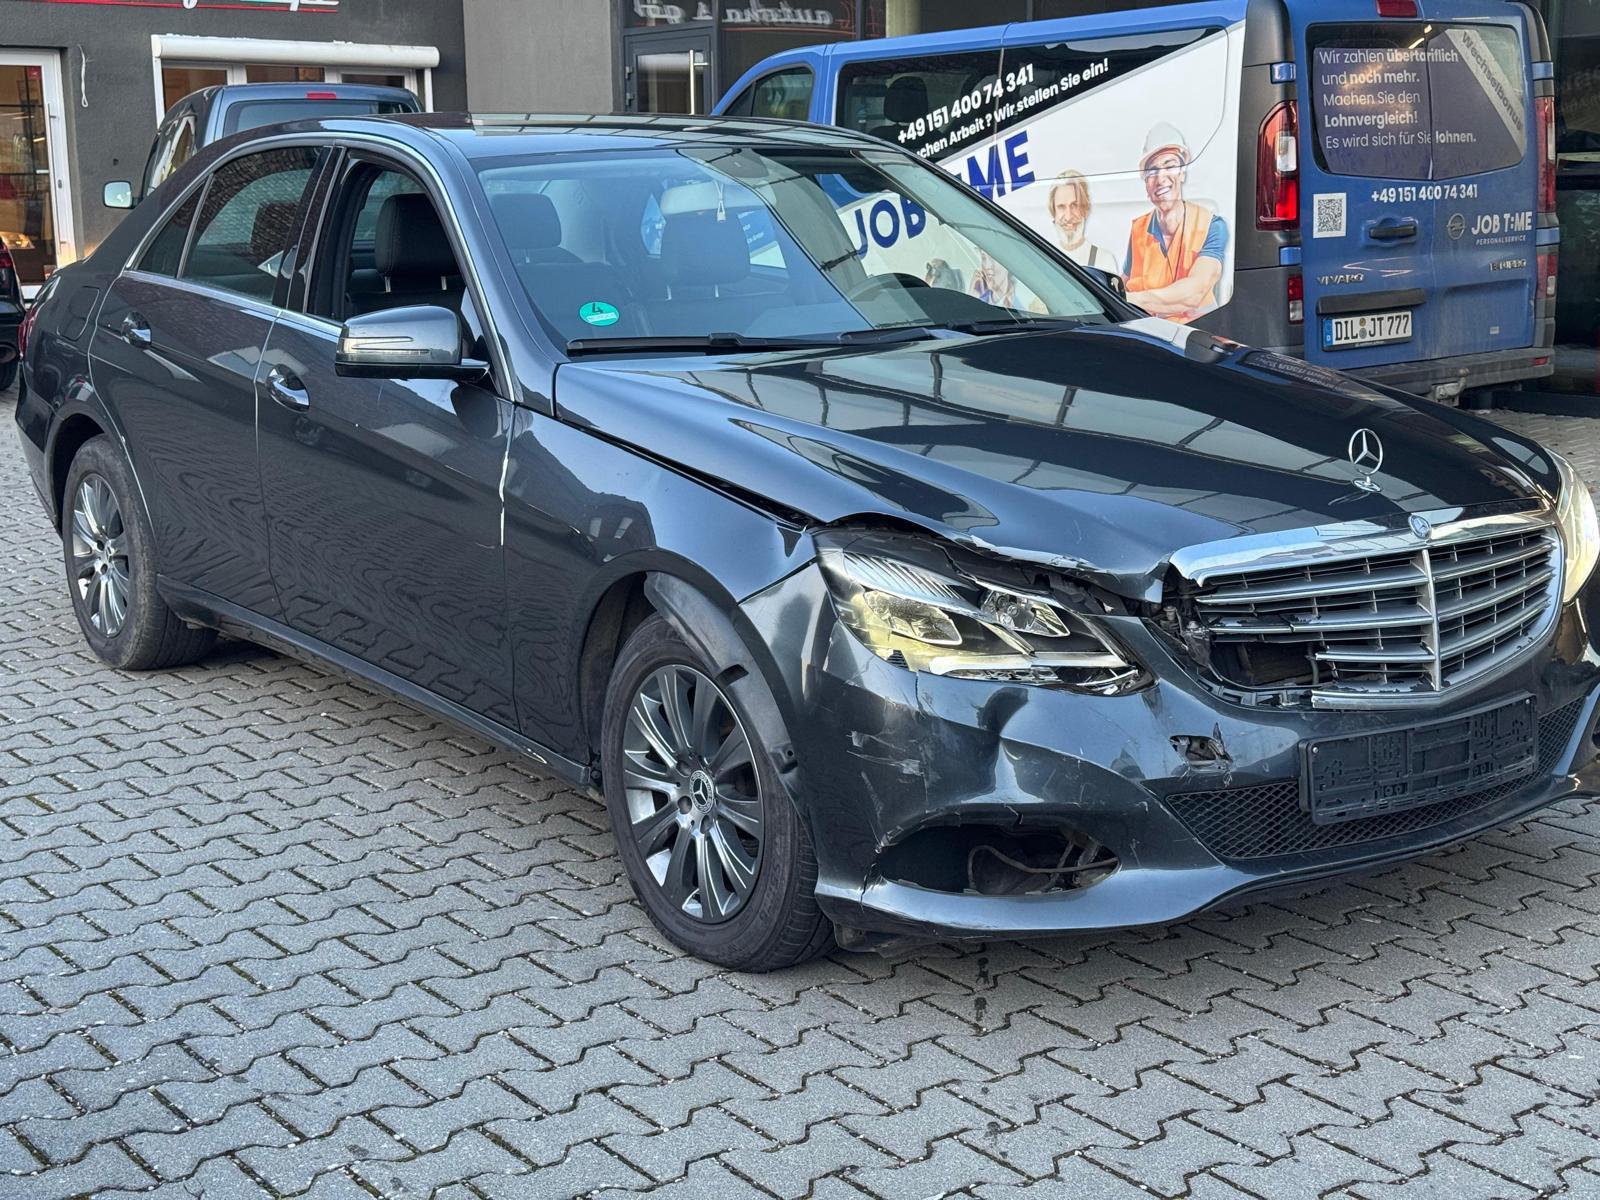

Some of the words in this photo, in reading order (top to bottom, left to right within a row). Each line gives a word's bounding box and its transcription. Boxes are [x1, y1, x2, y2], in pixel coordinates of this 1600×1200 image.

[1319, 50, 1340, 64] Wir
[1344, 51, 1385, 64] zahlen
[1386, 49, 1459, 63] übertariflich
[1322, 72, 1347, 85] und
[1350, 70, 1382, 84] noch
[1384, 69, 1420, 83] mehr.
[1462, 31, 1524, 131] Wechselbonus
[897, 115, 926, 144] +49
[926, 105, 950, 131] 151
[950, 90, 982, 119] 400
[983, 79, 1004, 105] 74
[1006, 63, 1034, 92] 341
[917, 137, 948, 159] chen
[949, 118, 985, 146] Arbeit
[994, 103, 1015, 123] Wir
[1016, 83, 1059, 114] stellen
[1060, 72, 1081, 91] Sie
[1082, 57, 1109, 81] ein!
[1323, 92, 1375, 107] Machen
[1377, 91, 1395, 104] Sie
[1397, 91, 1421, 103] den
[1325, 111, 1418, 129] Lohnvergleich!
[1326, 135, 1340, 149] Es
[1342, 133, 1369, 147] wird
[1372, 132, 1396, 146] sich
[1399, 131, 1414, 145] für
[1417, 131, 1432, 144] Sie
[1435, 130, 1477, 144] lohnen.
[1371, 187, 1396, 203] +49
[1398, 186, 1416, 202] 151
[1418, 185, 1442, 201] 400
[1444, 185, 1458, 200] 74
[1459, 184, 1478, 199] 341
[855, 196, 926, 260] JOB
[1471, 214, 1500, 235] JOB
[1475, 235, 1526, 246] PERSONALSERVICE
[1335, 320, 1358, 341] DIL
[1369, 316, 1385, 337] JT
[1387, 314, 1410, 336] 777
